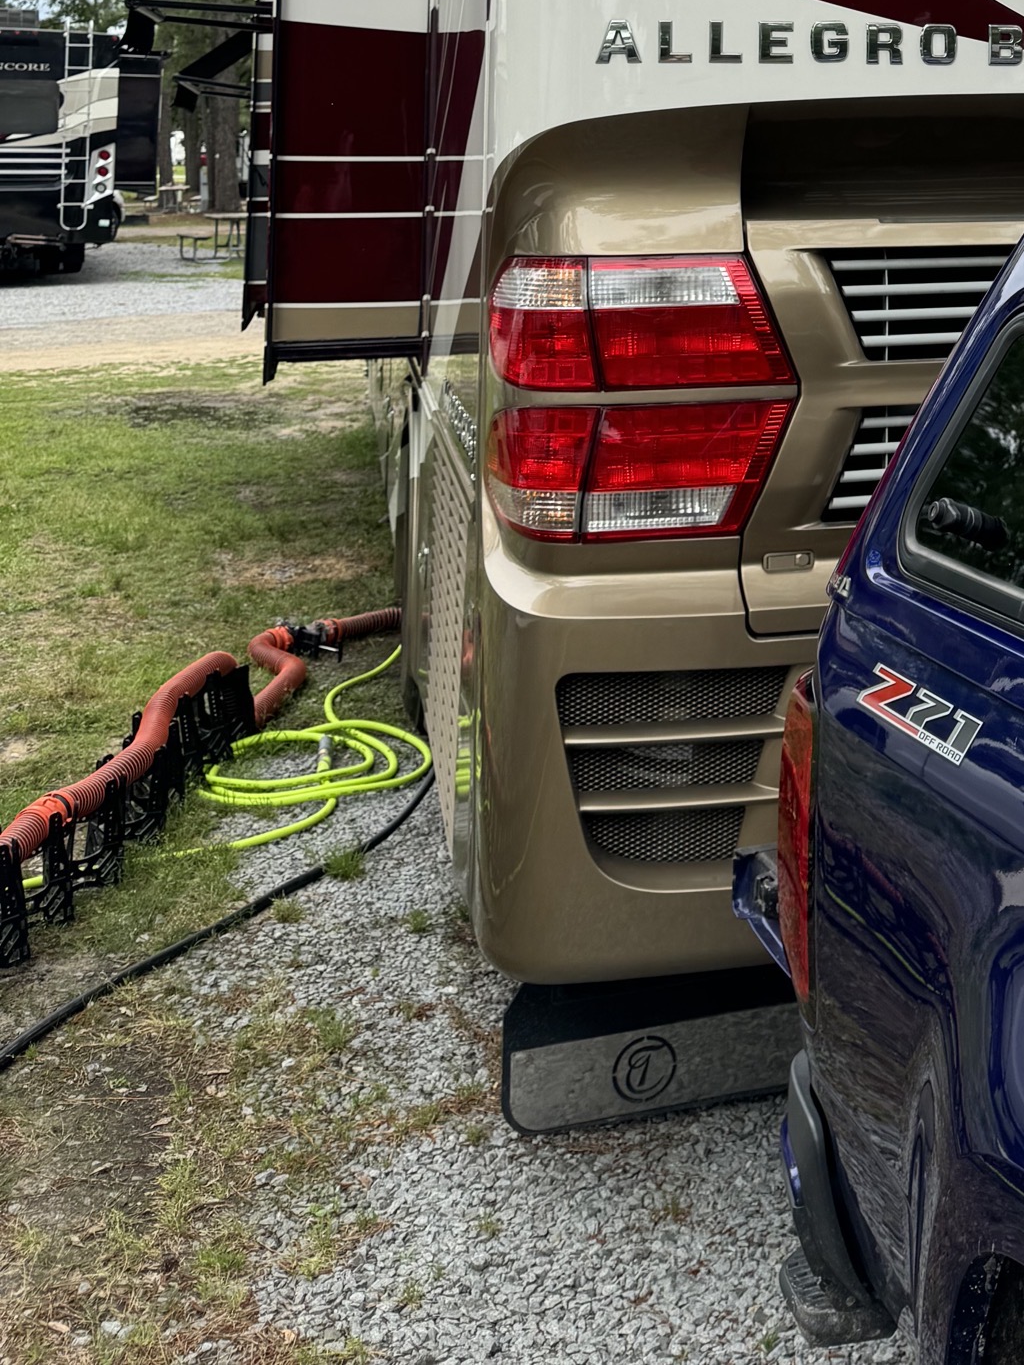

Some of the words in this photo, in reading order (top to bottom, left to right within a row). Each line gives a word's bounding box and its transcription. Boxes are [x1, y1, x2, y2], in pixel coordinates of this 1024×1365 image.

[595, 19, 958, 65] ALLEGRO
[856, 662, 984, 754] Z71
[918, 731, 936, 745] OFF
[936, 742, 962, 762] ROAD
